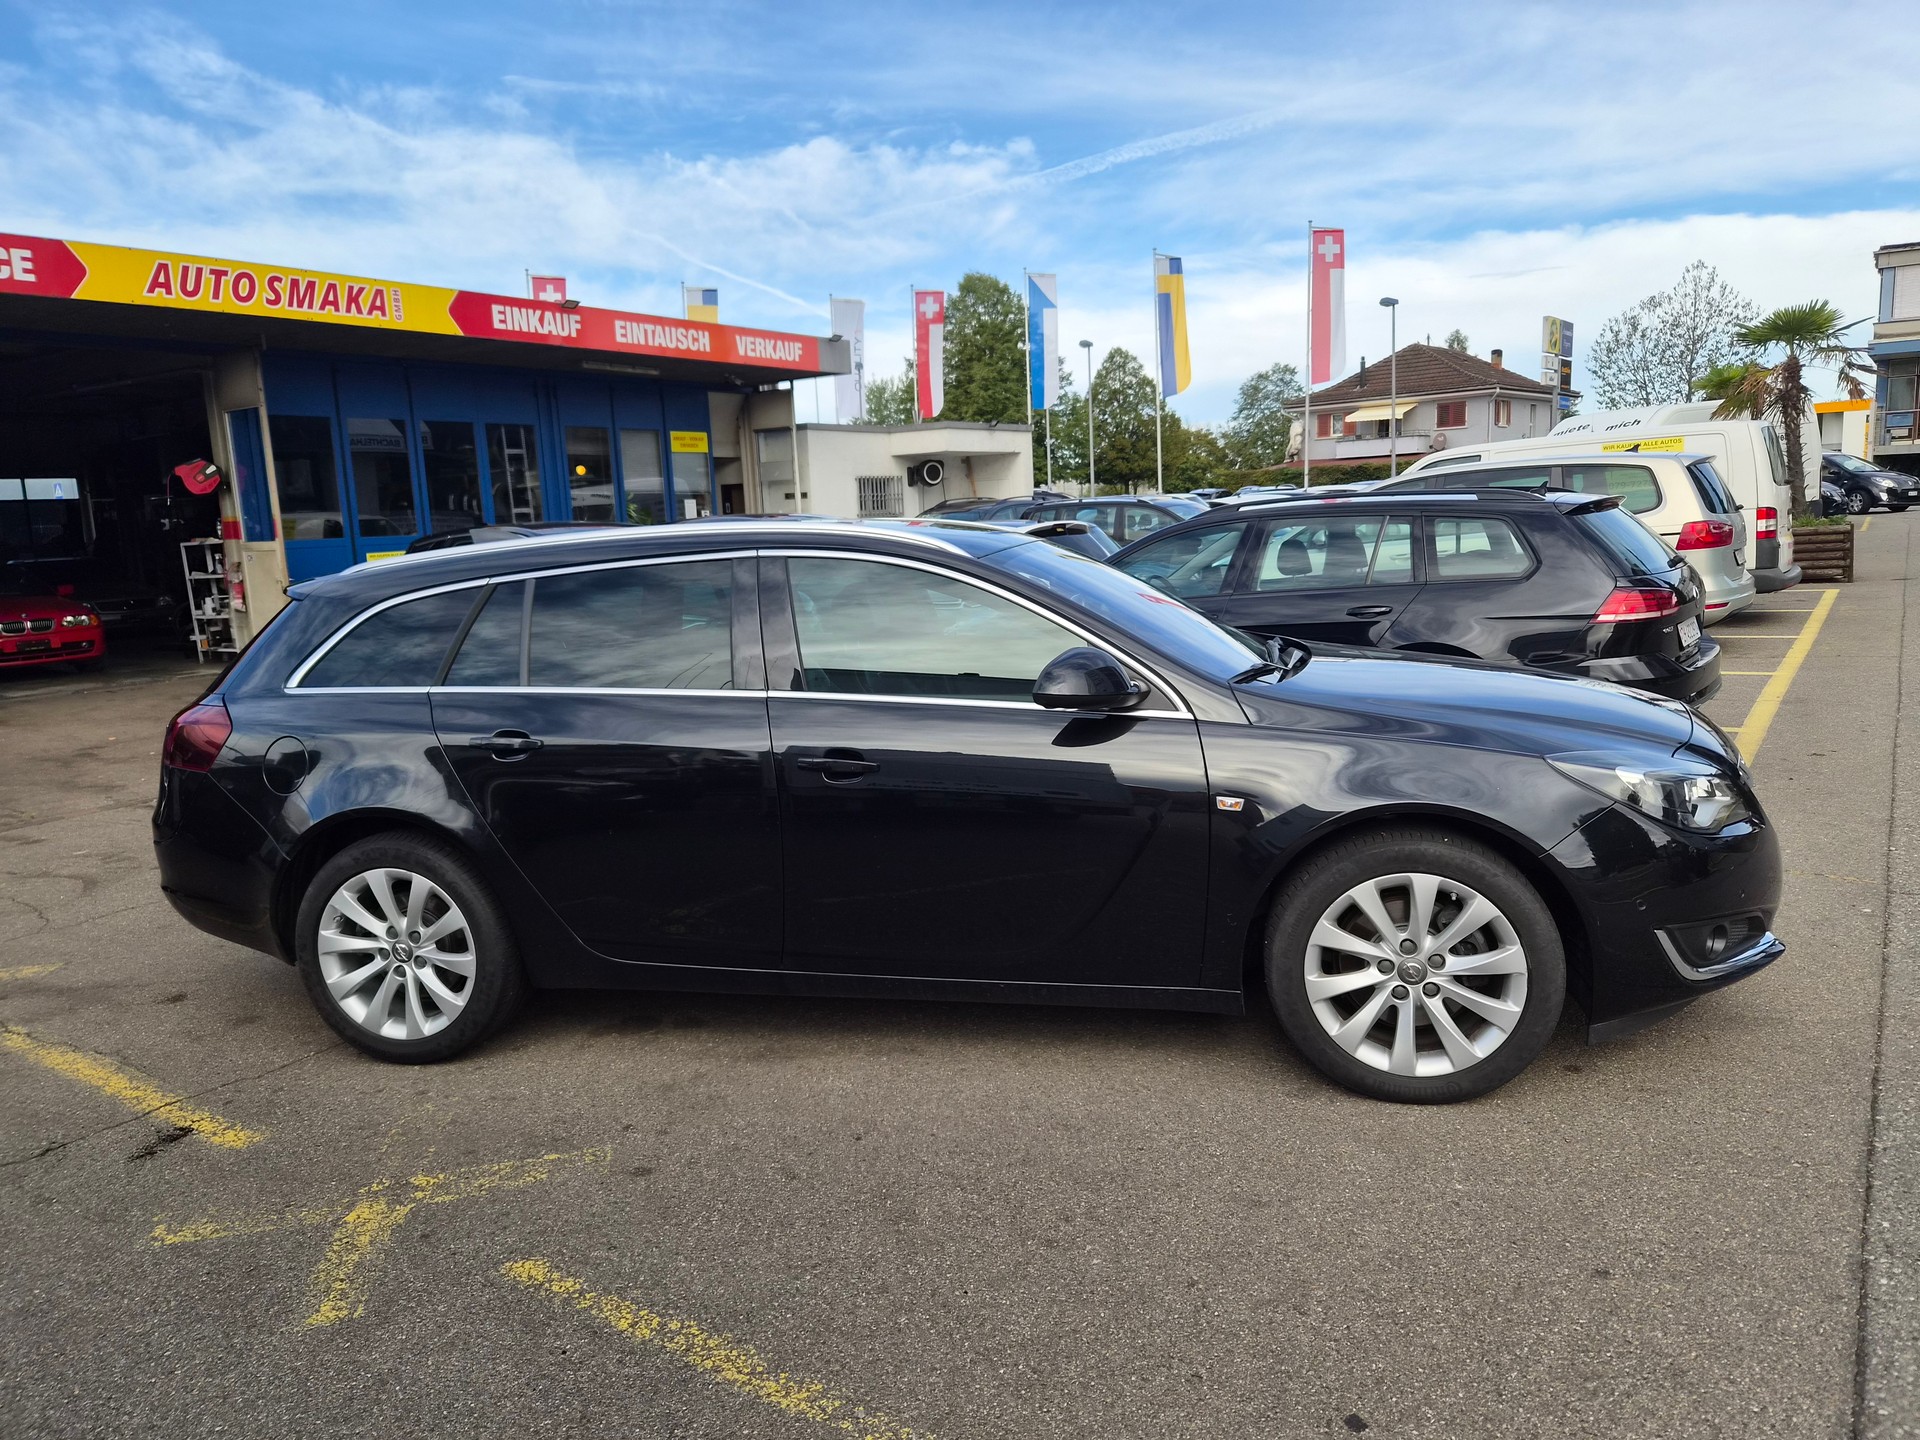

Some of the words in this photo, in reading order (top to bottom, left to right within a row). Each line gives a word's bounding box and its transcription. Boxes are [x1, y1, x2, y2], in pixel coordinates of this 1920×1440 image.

[146, 262, 257, 303] AUTO
[264, 275, 388, 318] SMAKA
[393, 289, 403, 321] GMBH
[491, 303, 582, 338] EINKAUF
[614, 319, 710, 352] EINTAUSCH
[735, 335, 802, 362] VERKAUF
[1553, 423, 1591, 436] miete
[1604, 418, 1642, 432] mich
